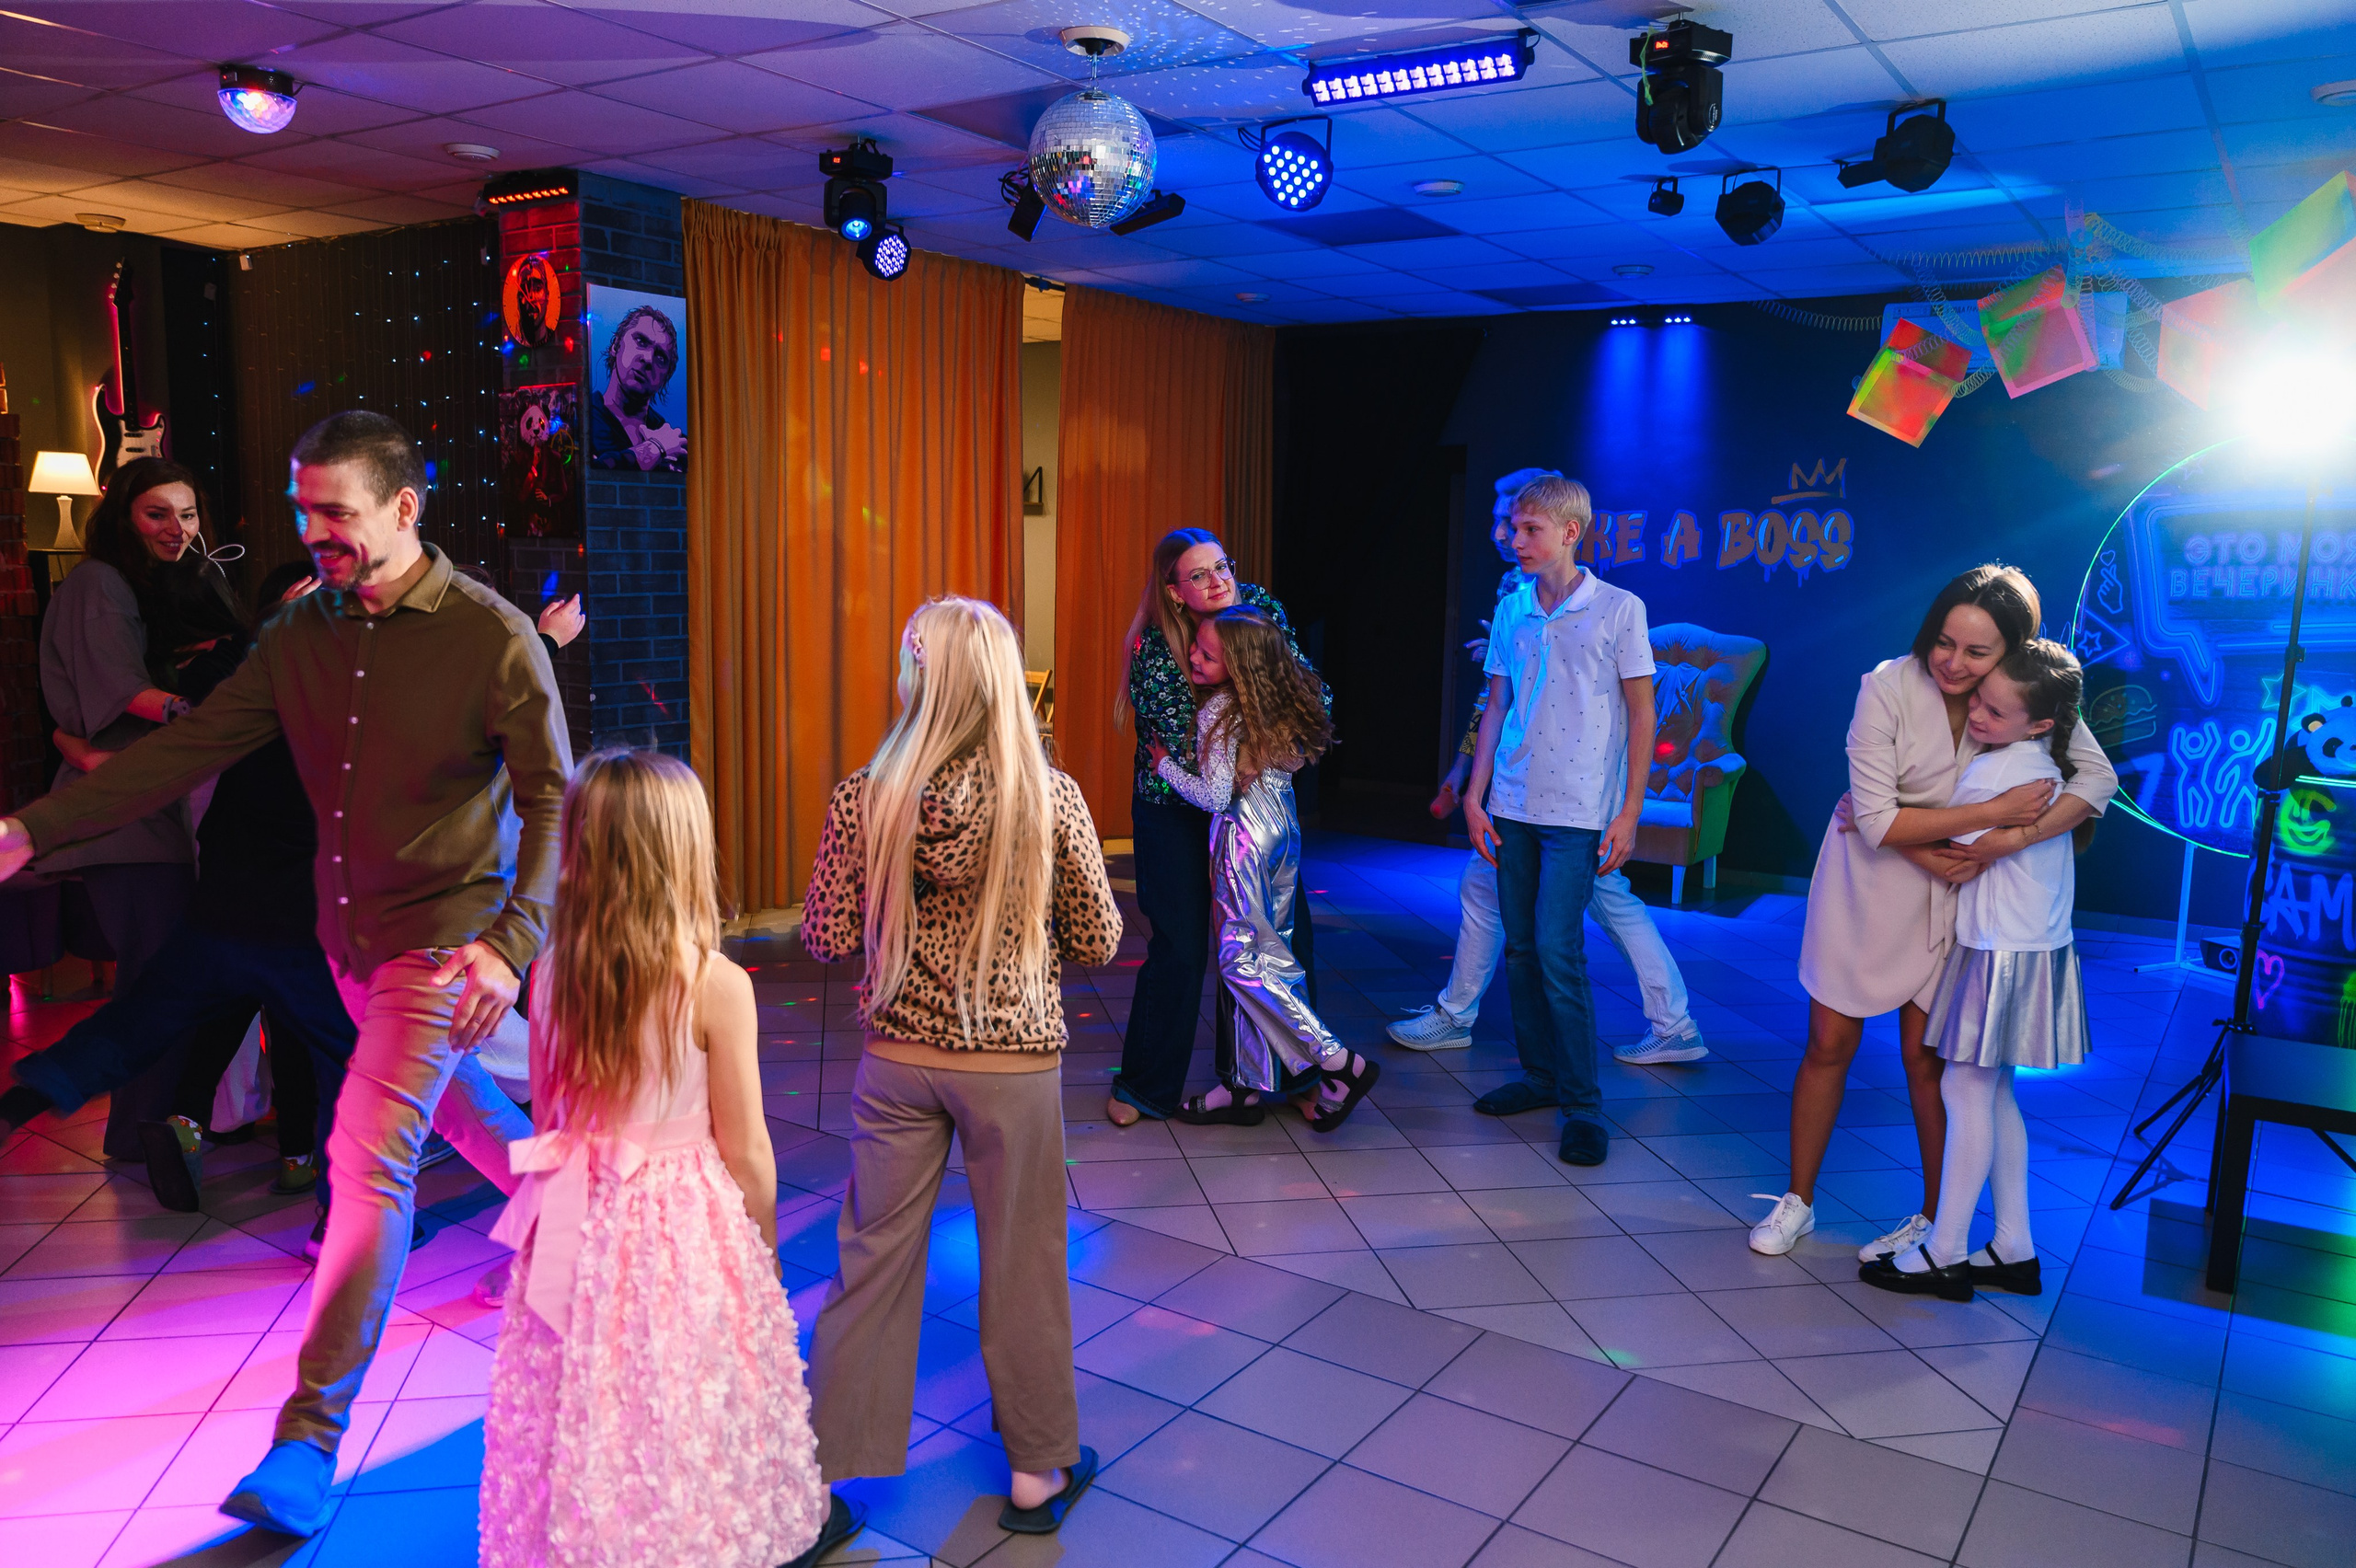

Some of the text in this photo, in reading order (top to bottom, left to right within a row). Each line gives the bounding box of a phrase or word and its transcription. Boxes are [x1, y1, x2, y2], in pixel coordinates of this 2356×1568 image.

[1573, 508, 1854, 574] KE A BOSS
[2183, 533, 2266, 566] ЭТО
